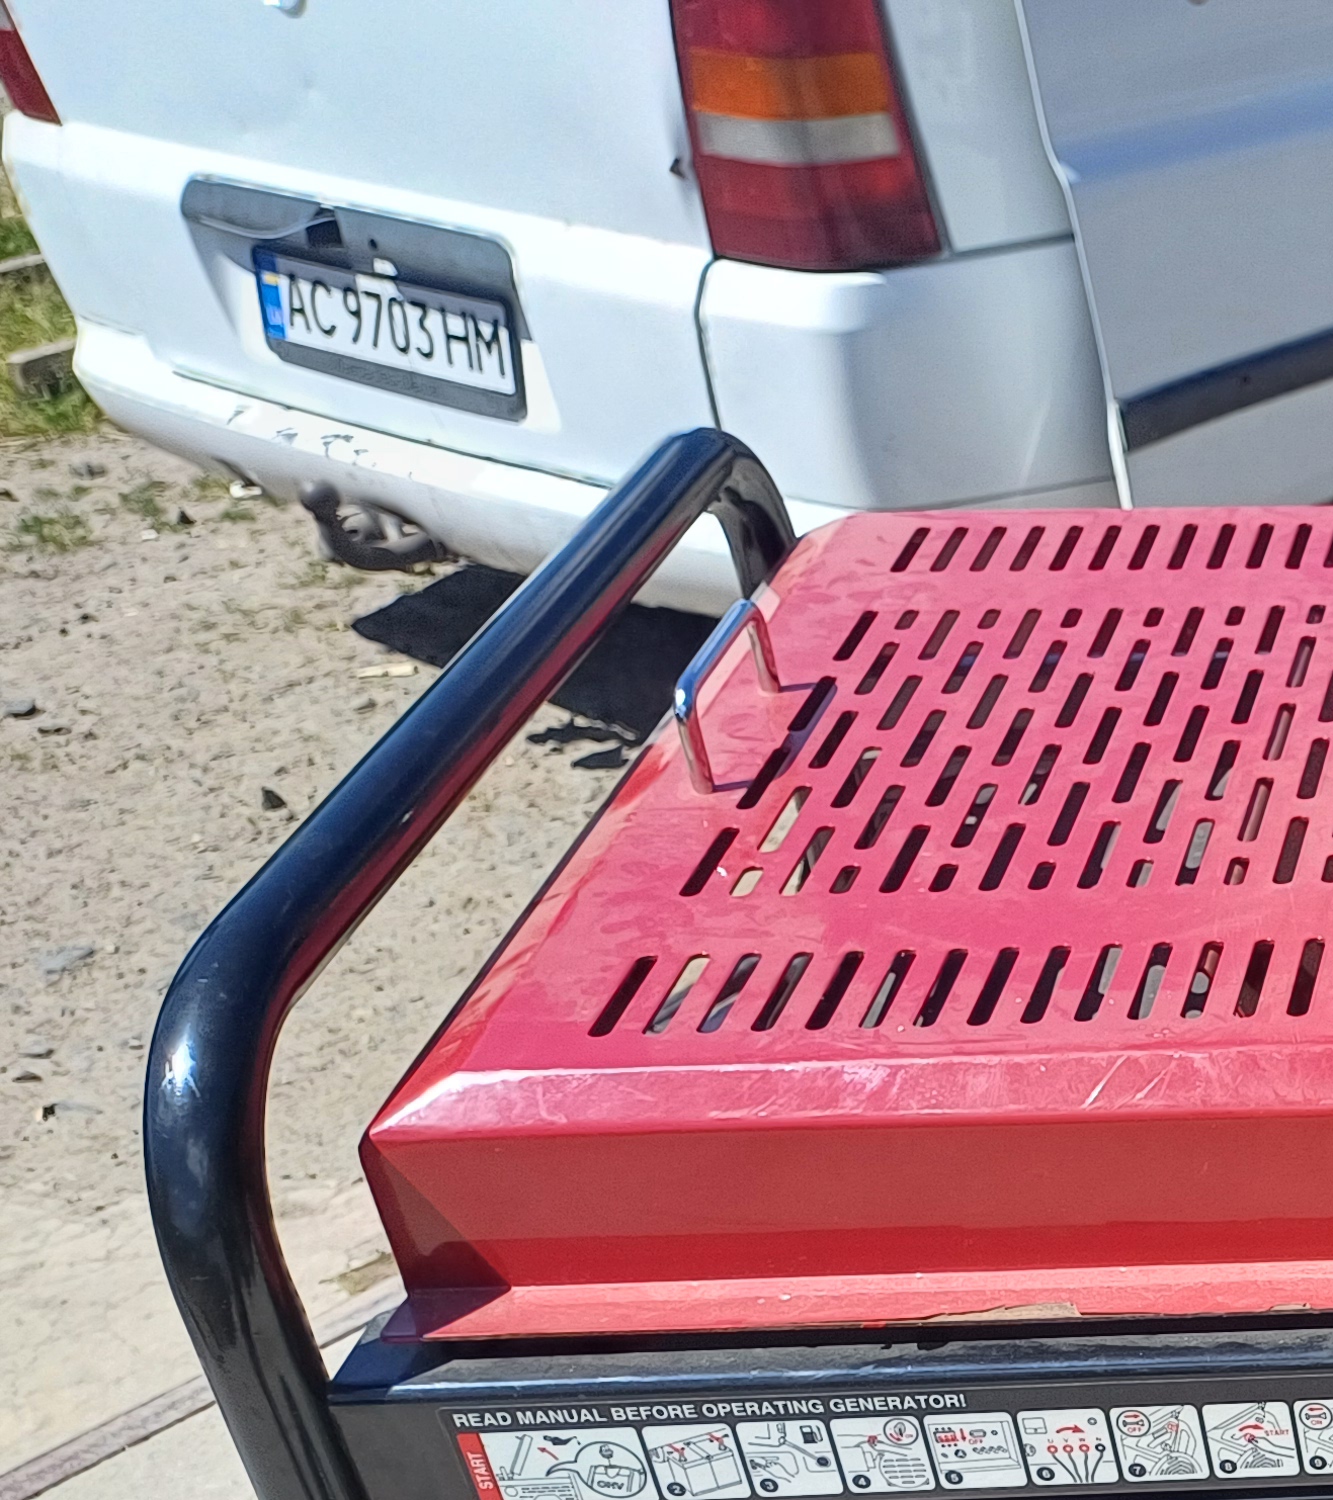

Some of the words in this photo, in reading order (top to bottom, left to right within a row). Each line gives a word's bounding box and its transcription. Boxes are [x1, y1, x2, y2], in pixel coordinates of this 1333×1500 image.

[288, 273, 337, 338] AC
[343, 286, 434, 359] 9703
[441, 307, 506, 378] HM
[453, 1412, 512, 1428] READ
[515, 1407, 607, 1425] MANUAL
[610, 1403, 698, 1421] BEFORE
[702, 1398, 824, 1418] OPERATING
[829, 1394, 967, 1414] GENERATOR!
[471, 1451, 494, 1490] START
